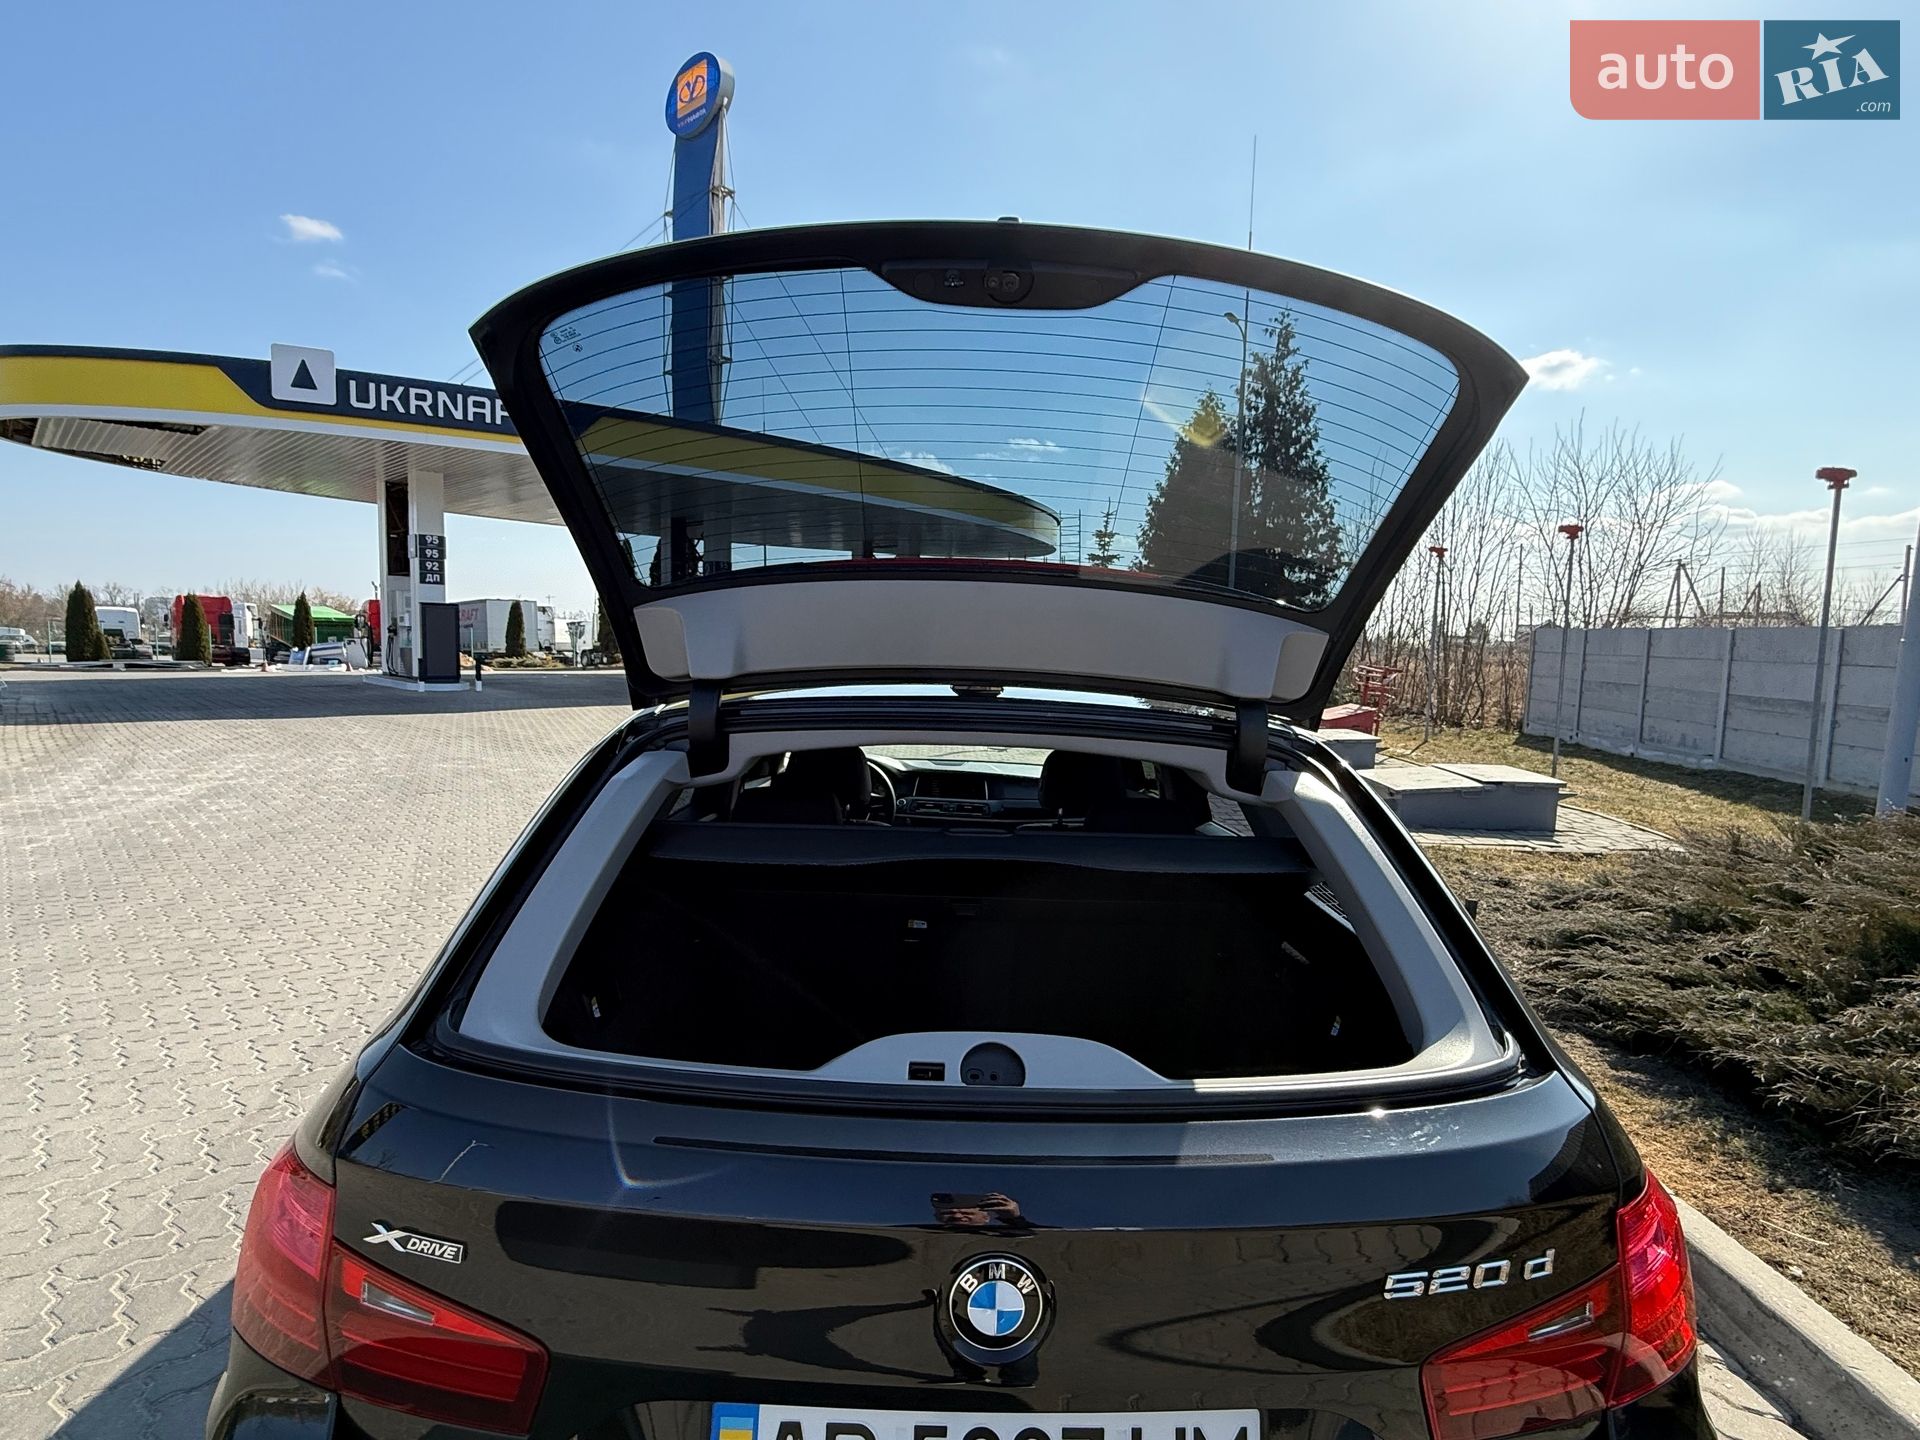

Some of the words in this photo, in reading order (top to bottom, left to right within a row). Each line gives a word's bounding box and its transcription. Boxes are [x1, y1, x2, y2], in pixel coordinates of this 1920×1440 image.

[425, 535, 439, 545] 95
[425, 548, 439, 559] 95
[425, 561, 439, 571] 92
[425, 573, 440, 583] ДП
[959, 1263, 1036, 1295] BMW
